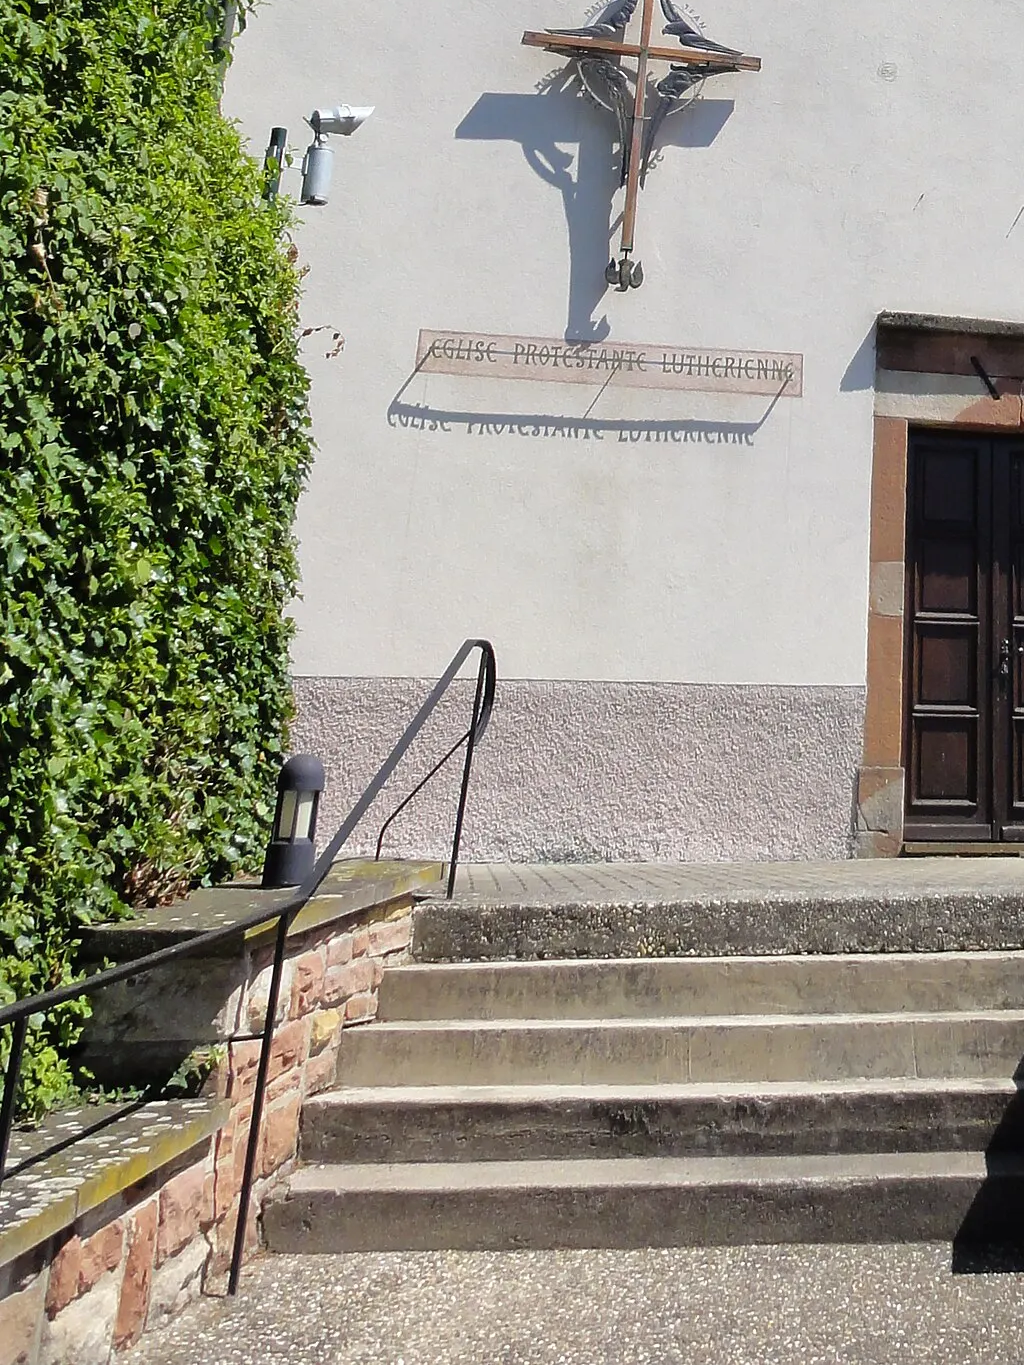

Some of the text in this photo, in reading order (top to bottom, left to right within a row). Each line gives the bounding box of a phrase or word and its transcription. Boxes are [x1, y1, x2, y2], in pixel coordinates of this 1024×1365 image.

[431, 338, 795, 382] EGLISE PROTESTANTE LUTHERIENNE
